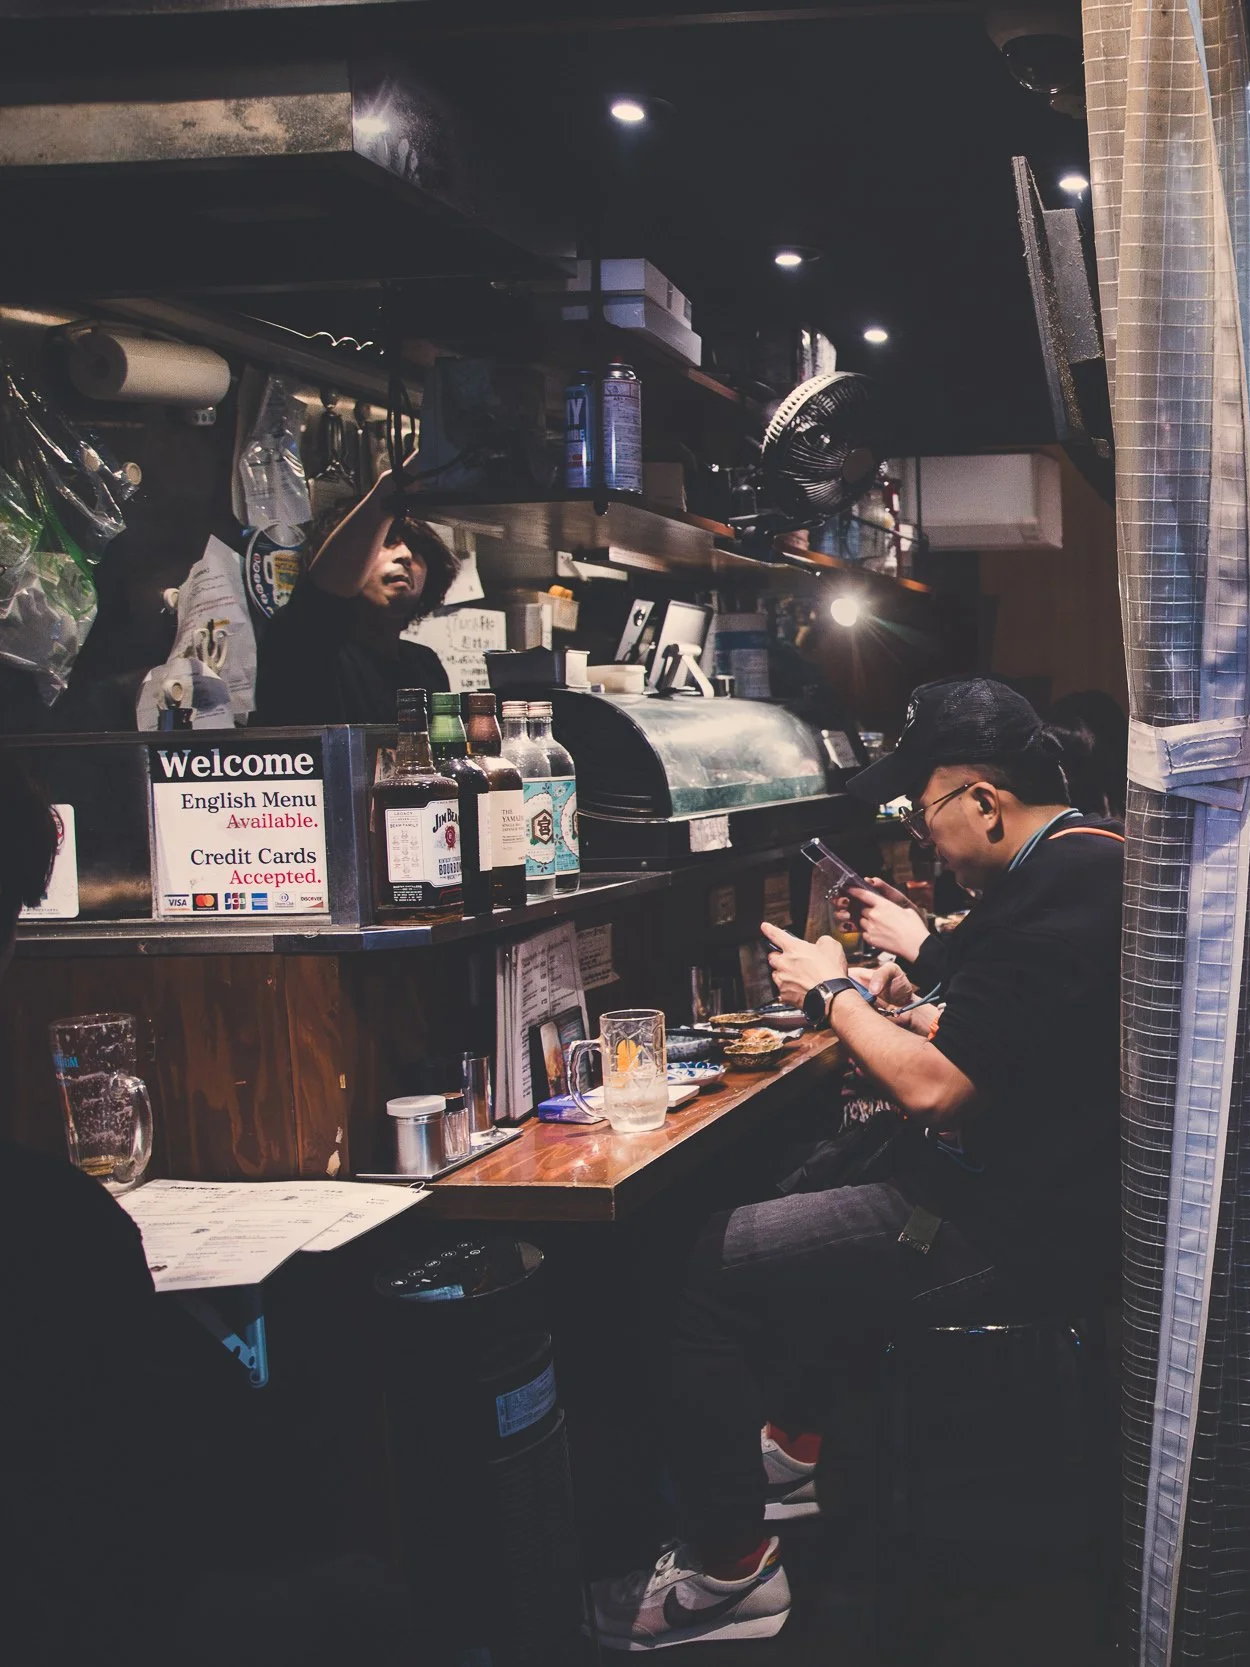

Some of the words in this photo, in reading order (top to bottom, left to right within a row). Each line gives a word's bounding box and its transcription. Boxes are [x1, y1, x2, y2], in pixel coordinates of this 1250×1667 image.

[157, 748, 314, 778] Welcome
[181, 792, 257, 813] English
[262, 791, 317, 808] Menu
[226, 813, 319, 829] Available.
[432, 813, 446, 833] JIM
[537, 815, 551, 836] 宮
[190, 848, 252, 865] Credit
[258, 847, 317, 864] Cards
[229, 868, 322, 888] Accepted.
[168, 898, 188, 907] VISA
